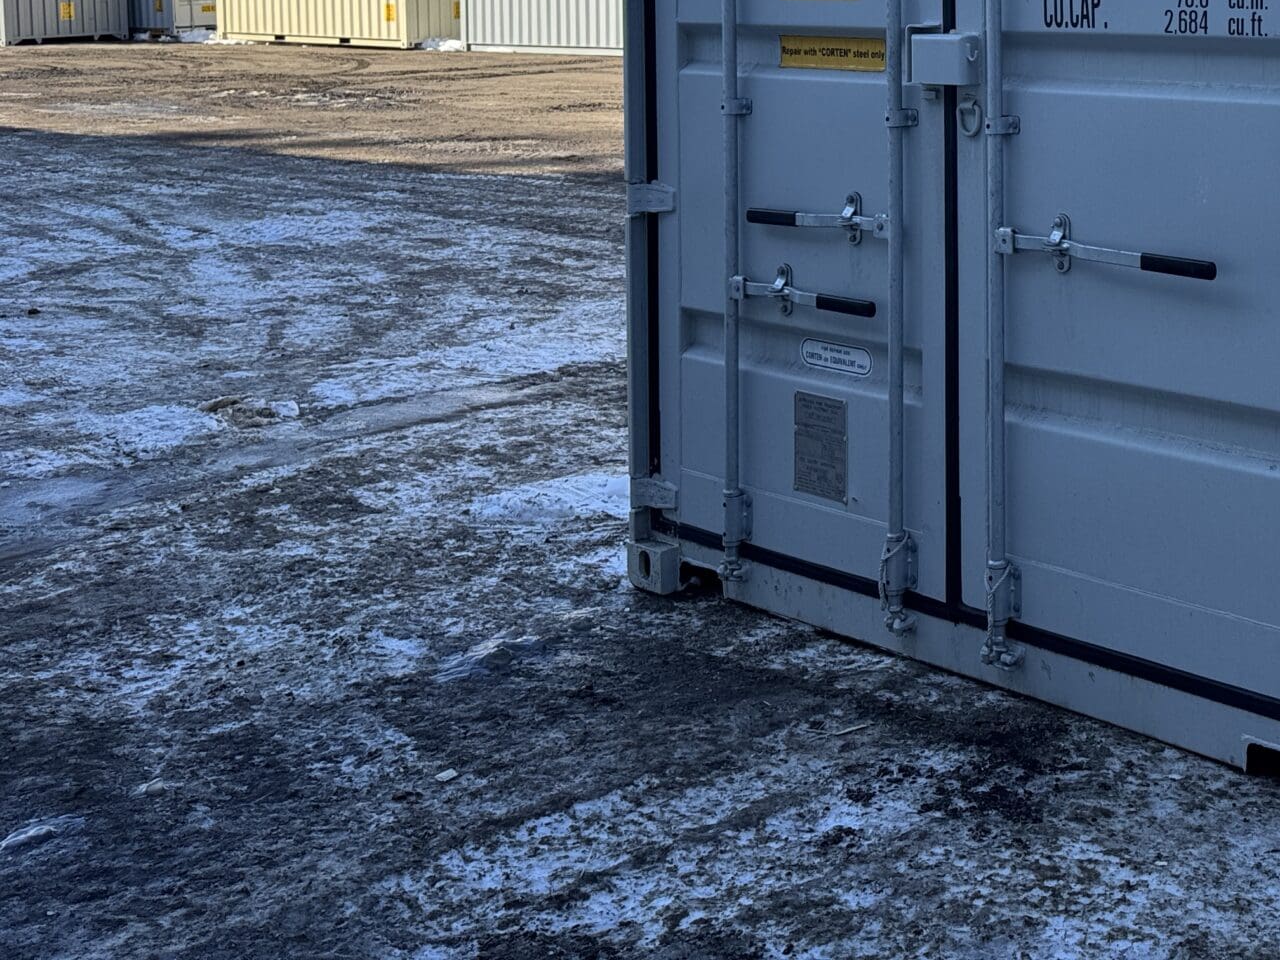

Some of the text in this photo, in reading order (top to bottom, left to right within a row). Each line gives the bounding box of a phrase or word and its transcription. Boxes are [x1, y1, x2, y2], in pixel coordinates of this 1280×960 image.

[1164, 9, 1268, 37] 2,684 cu.ft.
[782, 46, 802, 56] Repair
[803, 46, 817, 56] with
[853, 50, 869, 59] steel
[871, 50, 885, 61] only
